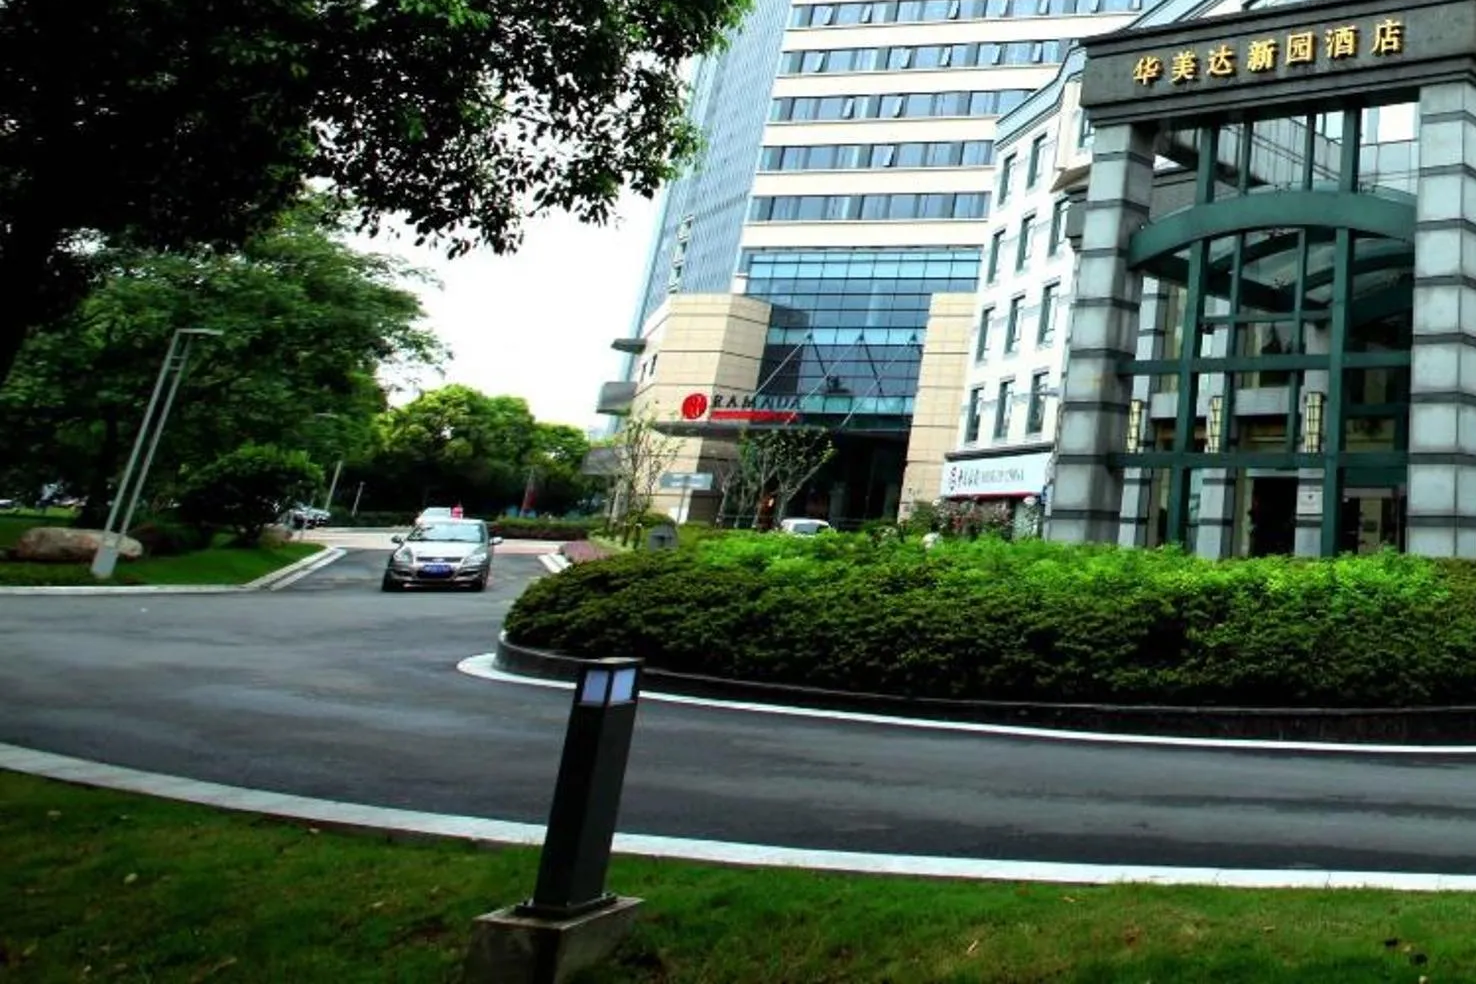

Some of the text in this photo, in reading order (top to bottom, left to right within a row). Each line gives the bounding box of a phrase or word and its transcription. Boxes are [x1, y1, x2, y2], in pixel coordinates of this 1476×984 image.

[1132, 18, 1406, 86] 华美达新园酒店
